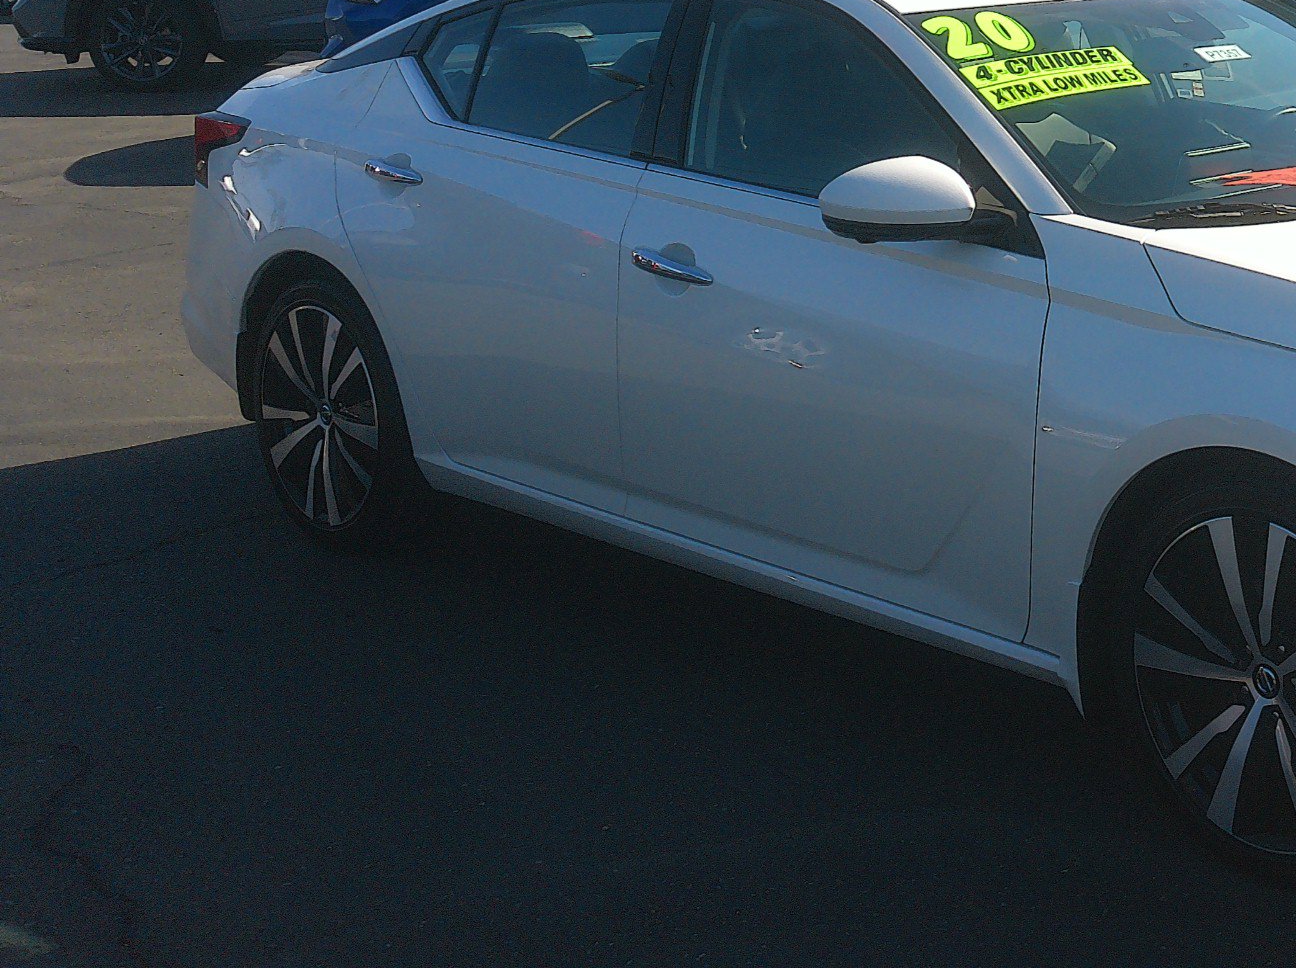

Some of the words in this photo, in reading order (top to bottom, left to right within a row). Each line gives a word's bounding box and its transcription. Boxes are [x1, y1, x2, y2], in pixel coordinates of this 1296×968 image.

[921, 10, 1036, 60] 20
[975, 47, 1118, 83] 4-CYLINDER
[1205, 48, 1242, 60] P7357
[990, 84, 1045, 106] XTRA
[1047, 75, 1083, 94] LOW
[1083, 69, 1140, 89] MILES
